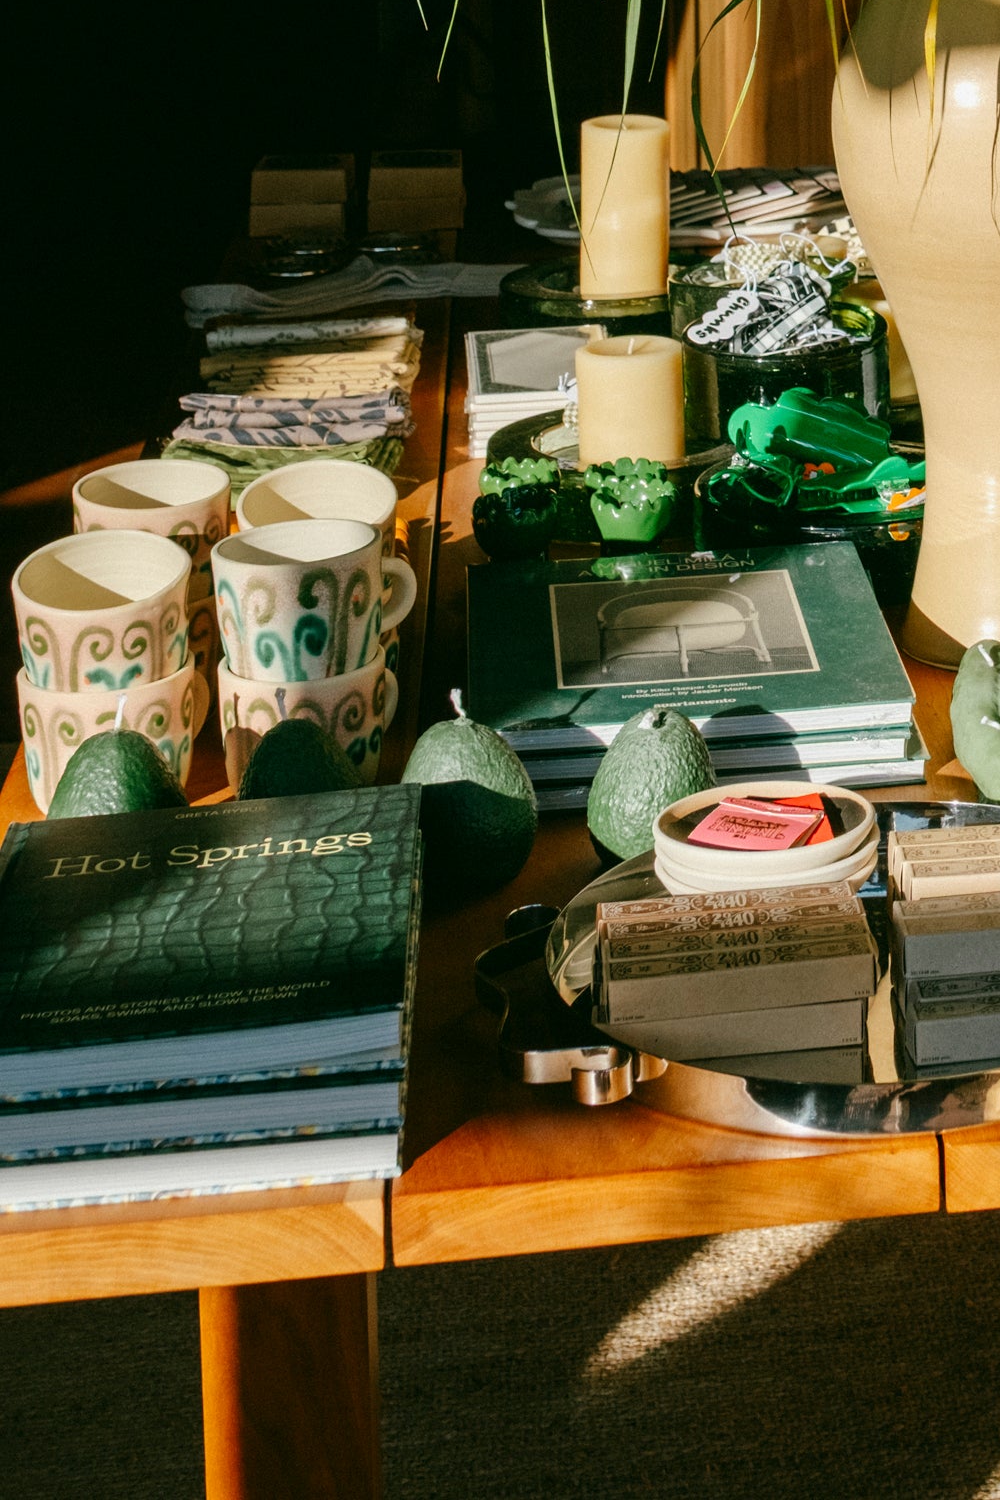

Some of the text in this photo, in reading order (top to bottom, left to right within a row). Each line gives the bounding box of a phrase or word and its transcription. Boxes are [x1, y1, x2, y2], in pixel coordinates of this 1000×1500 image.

[648, 565, 669, 573] IN
[676, 559, 755, 572] DESIGN
[621, 684, 764, 700] Introduction by Jasper Morrison
[653, 697, 737, 709] apartamento
[175, 810, 219, 820] GRETA
[43, 831, 373, 879] Hot Springs
[20, 980, 331, 1020] PHOTOS AND STORIES OF HOW THE WORLD
[163, 1003, 194, 1013] AND
[198, 997, 249, 1008] SLOWS
[252, 991, 298, 1002] DOWN
